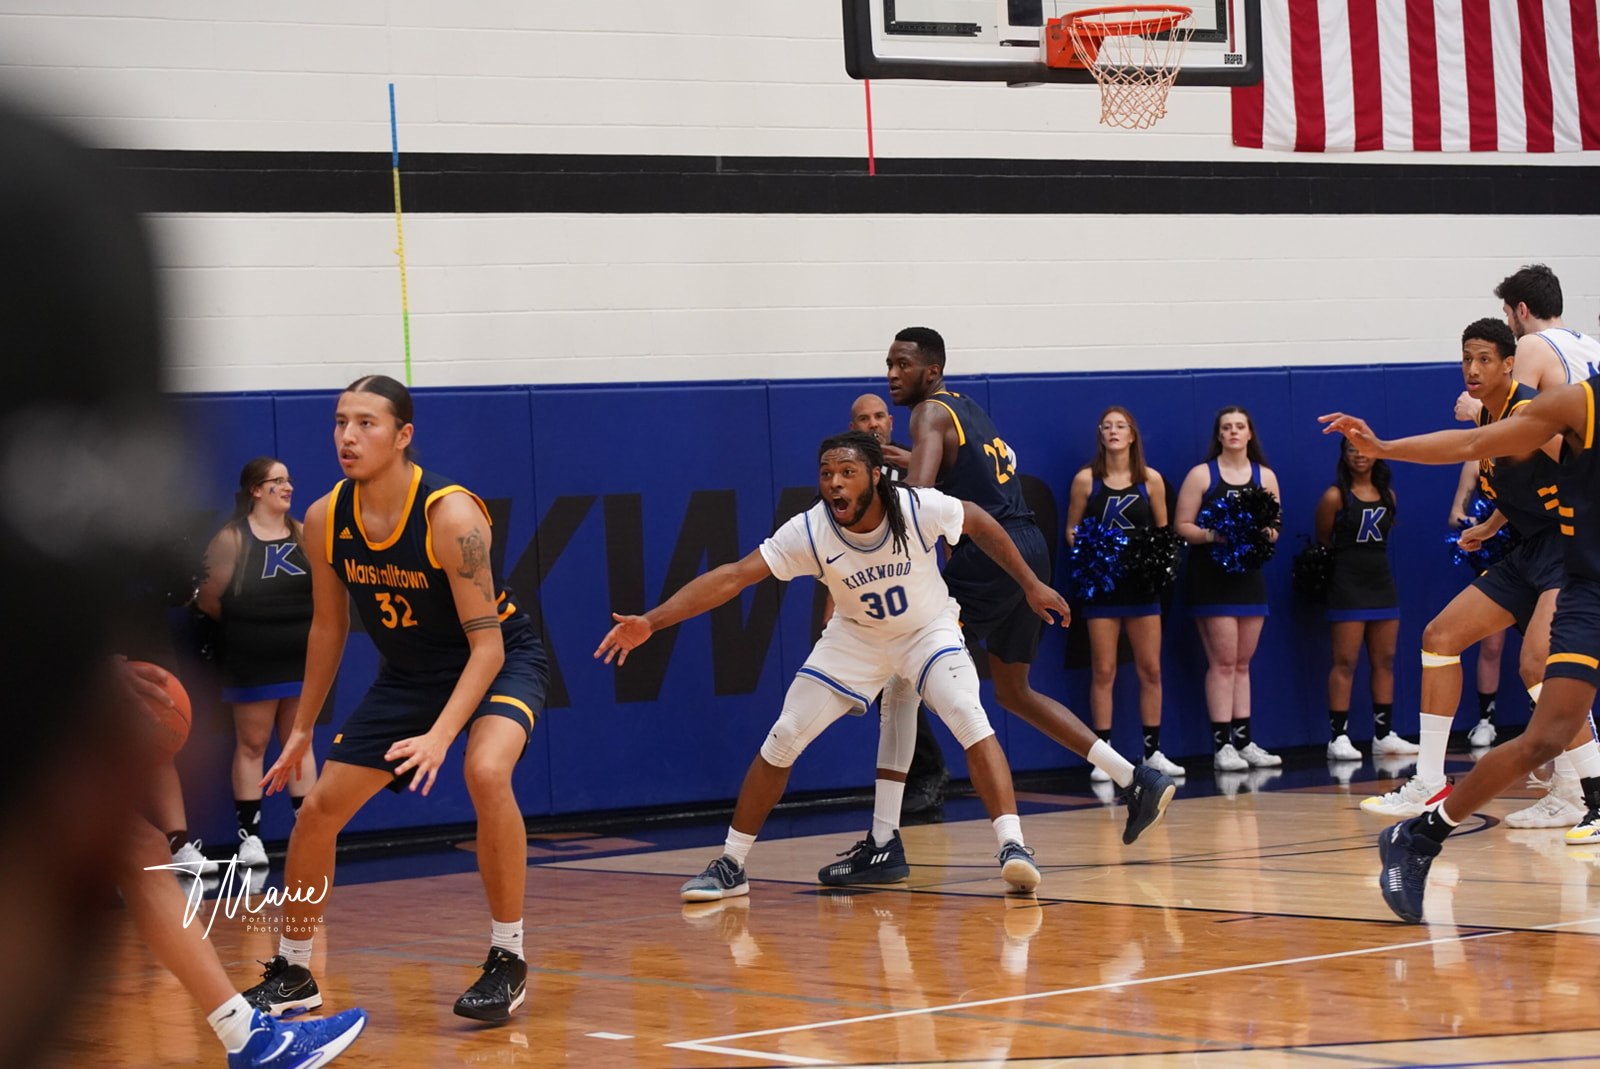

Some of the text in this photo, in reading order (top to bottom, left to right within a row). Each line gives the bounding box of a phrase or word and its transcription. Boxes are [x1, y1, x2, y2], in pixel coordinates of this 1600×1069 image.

[1102, 494, 1140, 530] K
[1356, 506, 1387, 542] K
[261, 542, 307, 579] K
[842, 561, 912, 590] KIRKWOOD
[375, 592, 418, 629] 32
[859, 585, 909, 620] 30
